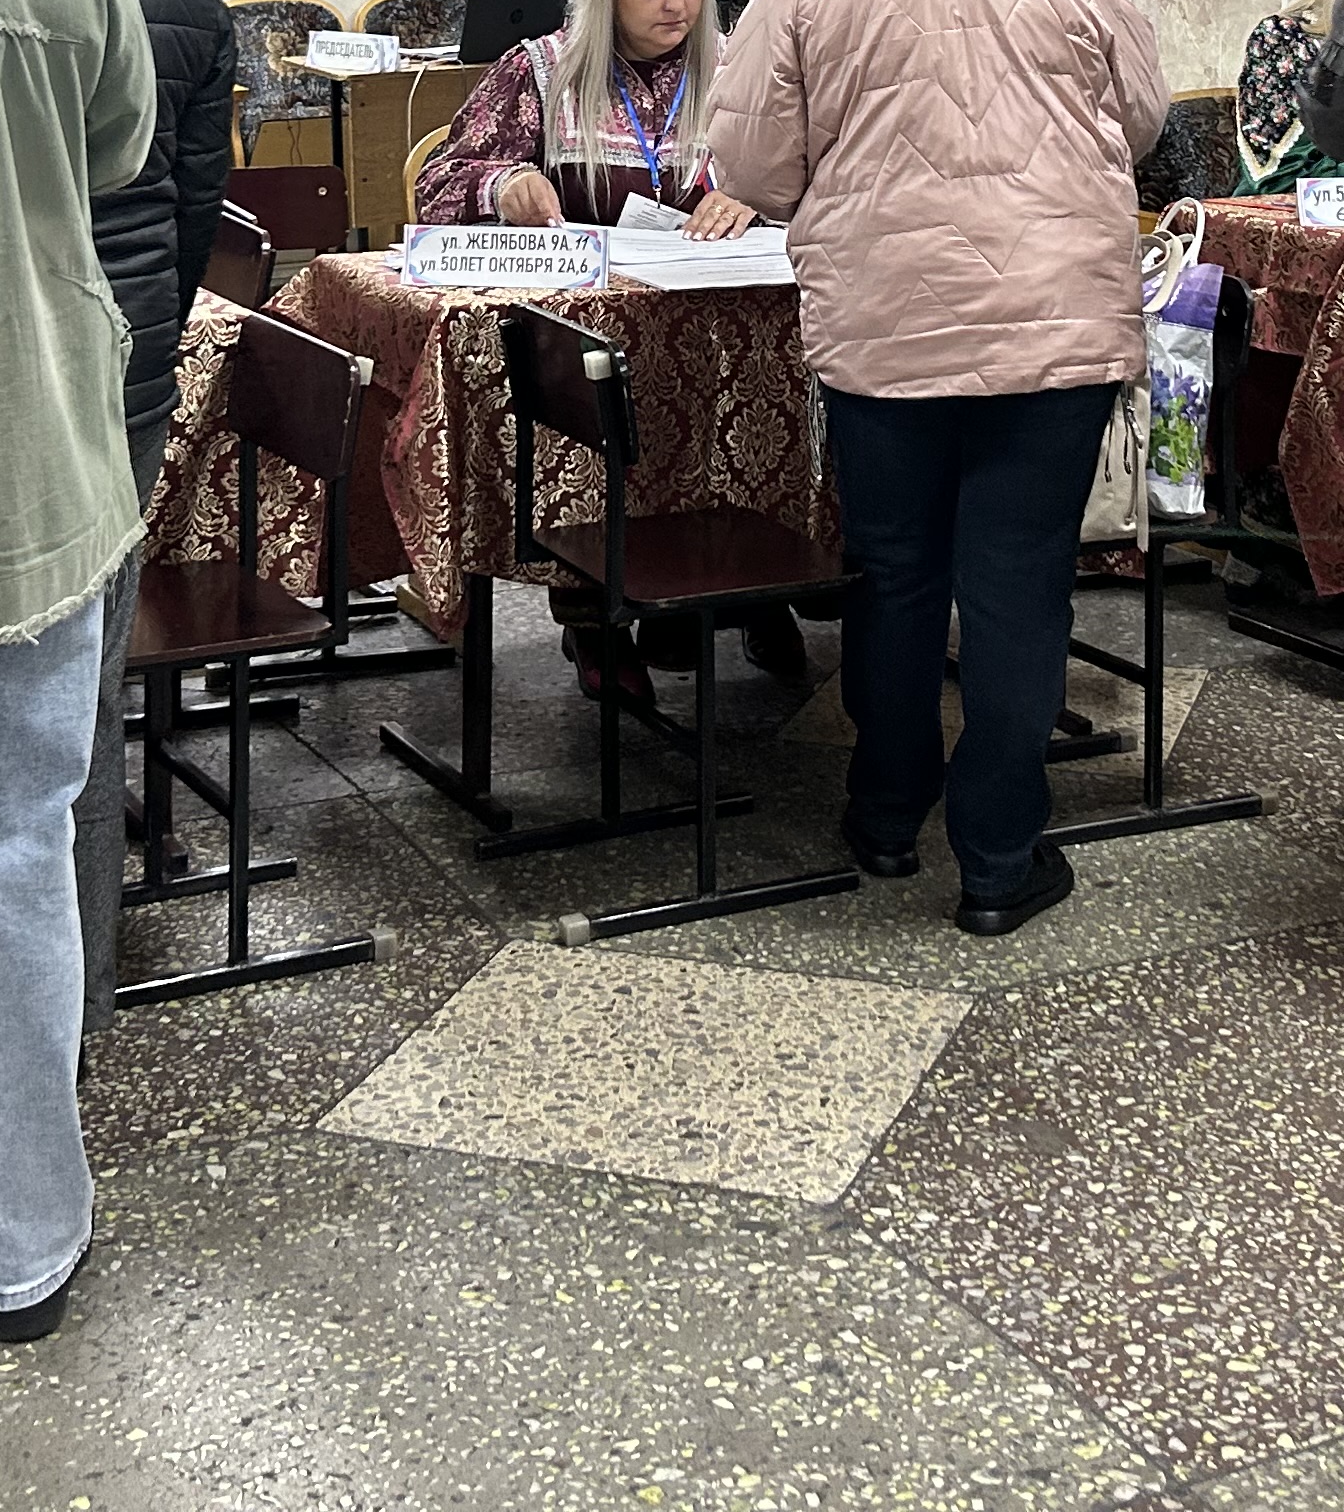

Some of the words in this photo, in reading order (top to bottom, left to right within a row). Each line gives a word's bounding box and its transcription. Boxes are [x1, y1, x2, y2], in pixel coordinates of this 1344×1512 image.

[315, 40, 374, 59] ПРЕДСЕДАТЕЛЬ
[441, 236, 462, 253] ул.
[466, 233, 546, 250] ЖЕЛЯБОВА
[575, 235, 591, 251] 11
[488, 257, 553, 273] ОКТЯБРЯ
